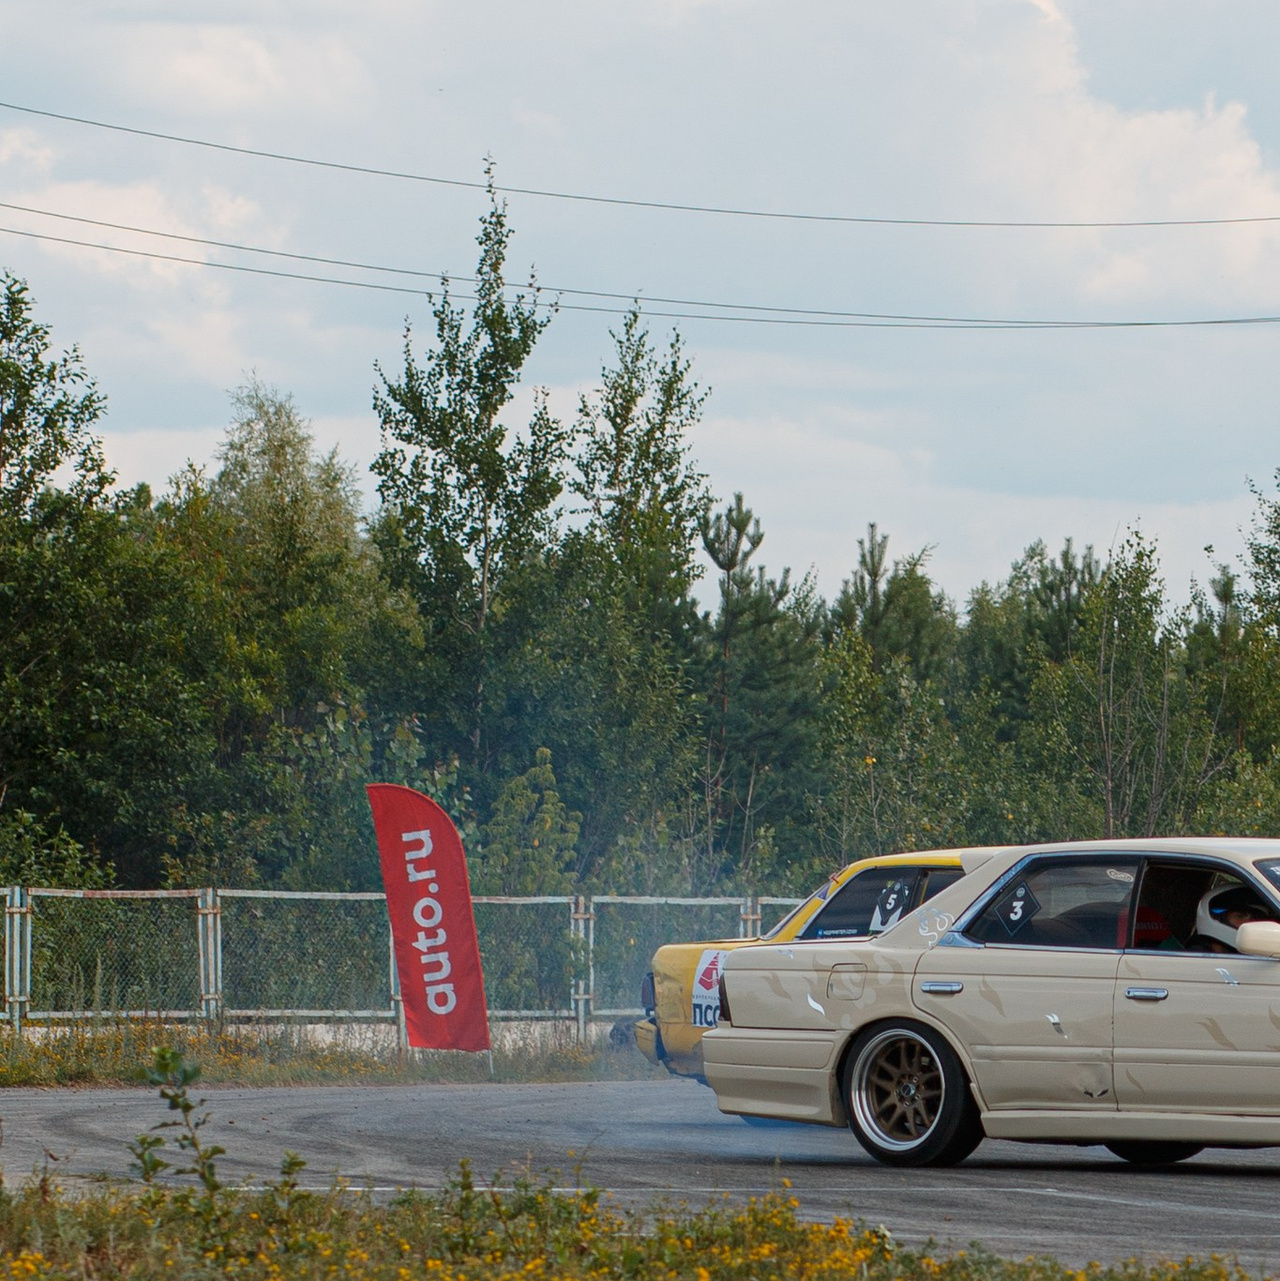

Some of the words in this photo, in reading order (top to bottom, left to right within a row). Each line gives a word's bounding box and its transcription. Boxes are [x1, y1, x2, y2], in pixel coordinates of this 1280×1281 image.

[886, 894, 898, 910] 5
[1010, 901, 1024, 920] 3
[401, 829, 457, 1015] auto.ru
